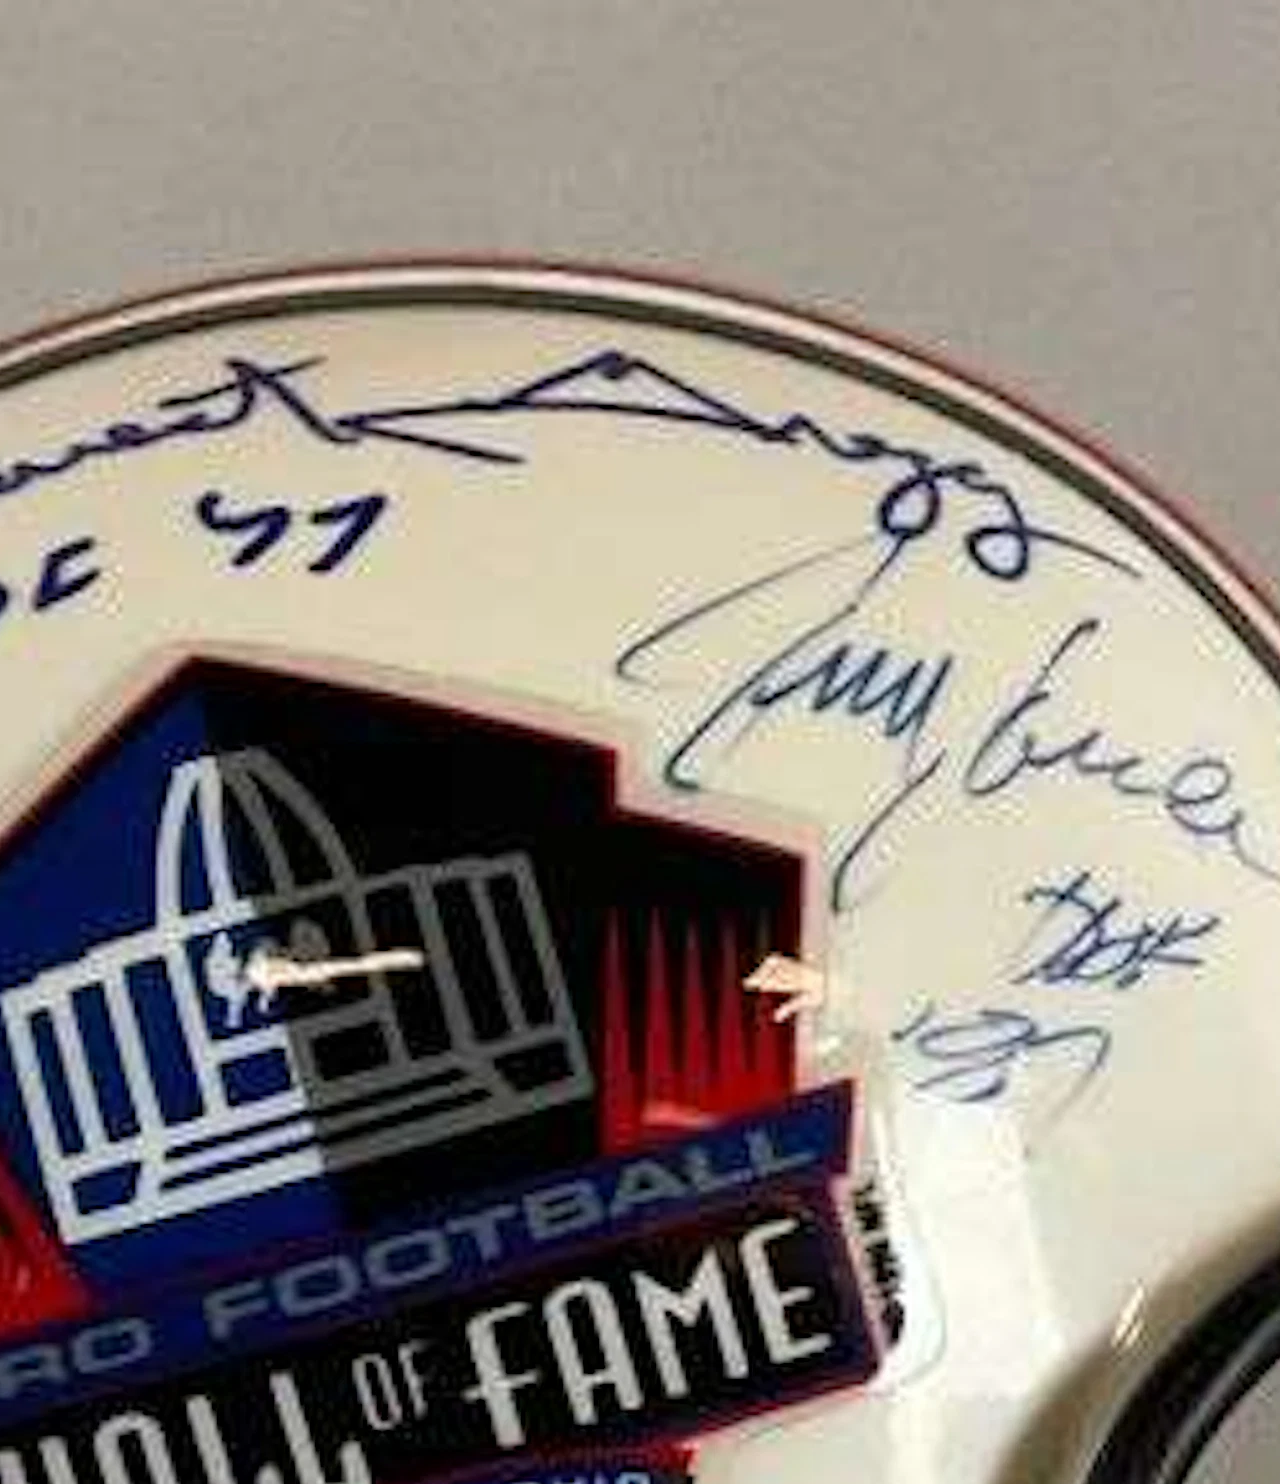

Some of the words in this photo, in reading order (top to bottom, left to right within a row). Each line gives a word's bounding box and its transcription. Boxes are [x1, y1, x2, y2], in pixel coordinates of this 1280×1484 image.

[202, 1130, 821, 1340] FOOTBALL
[352, 1340, 436, 1432] OF
[463, 1216, 833, 1449] FAME
